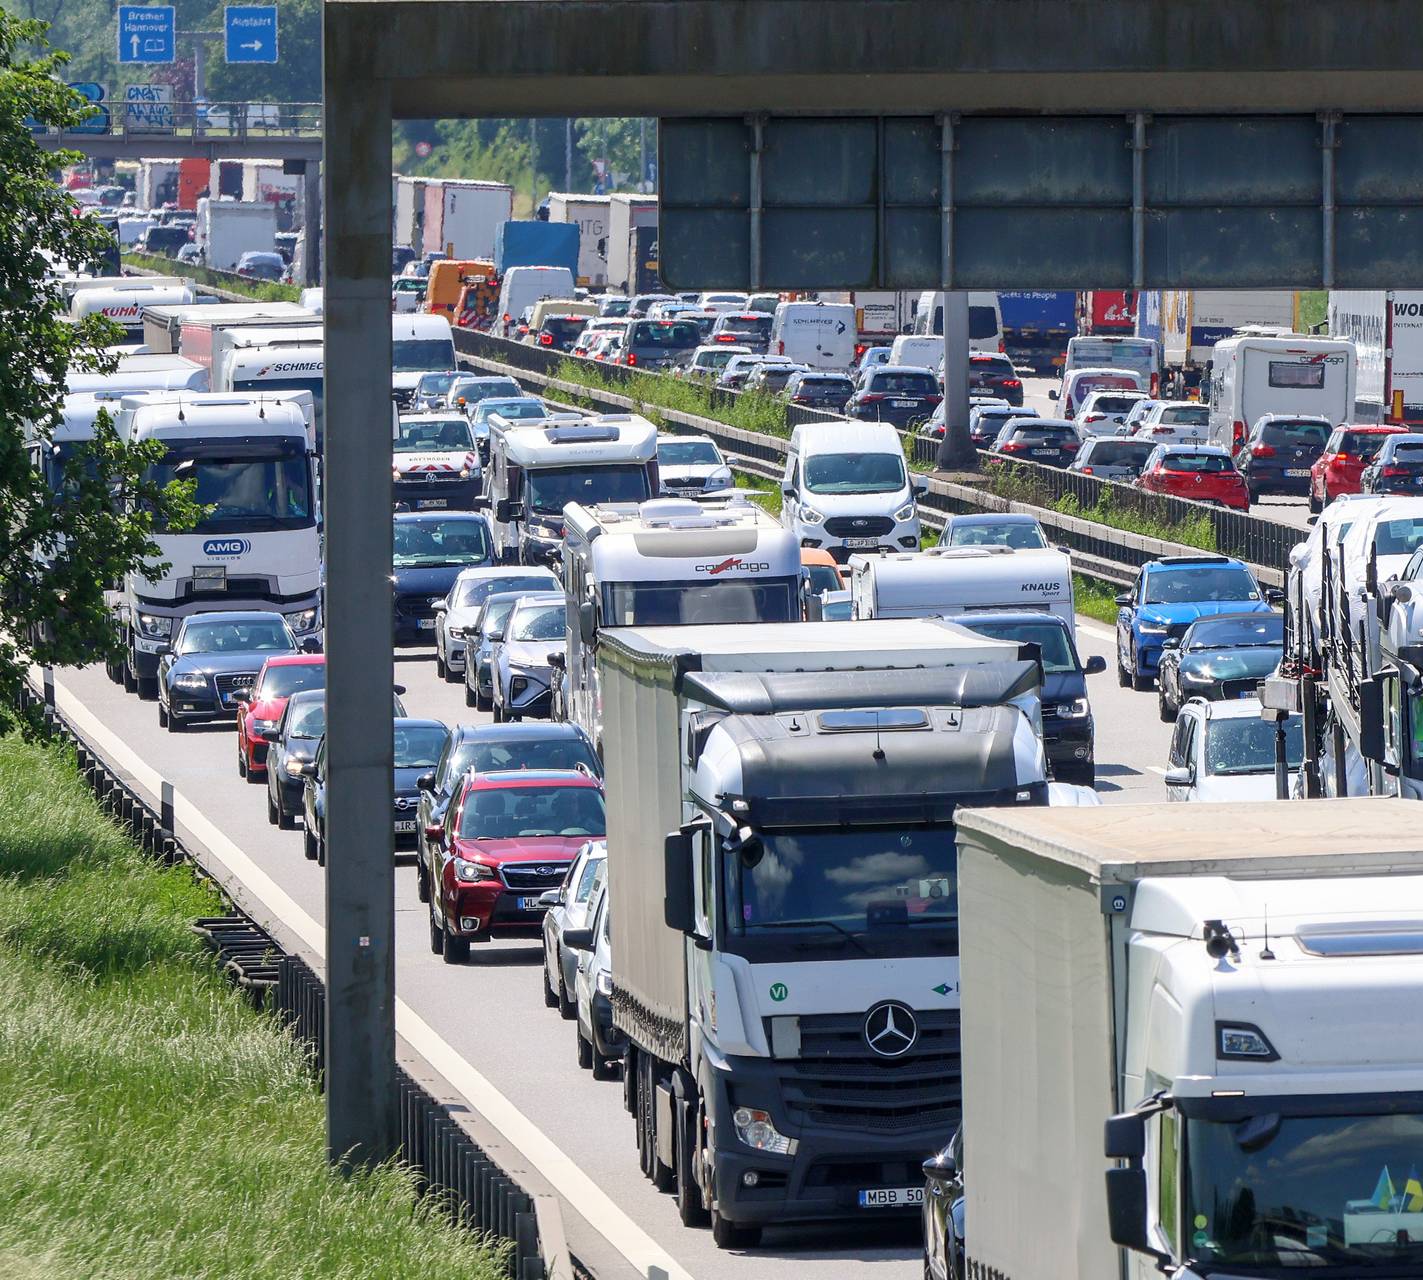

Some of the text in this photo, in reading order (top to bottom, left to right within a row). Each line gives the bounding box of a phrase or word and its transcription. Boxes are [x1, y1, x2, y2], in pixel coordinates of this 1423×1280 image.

[128, 12, 164, 20] Bremen
[231, 18, 271, 27] Ausfahrt
[124, 23, 169, 32] Hannover
[101, 306, 138, 317] KUHN
[206, 542, 241, 552] AMG
[1021, 583, 1060, 591] KNAUS
[771, 987, 787, 998] VI
[867, 1190, 898, 1203] MBB
